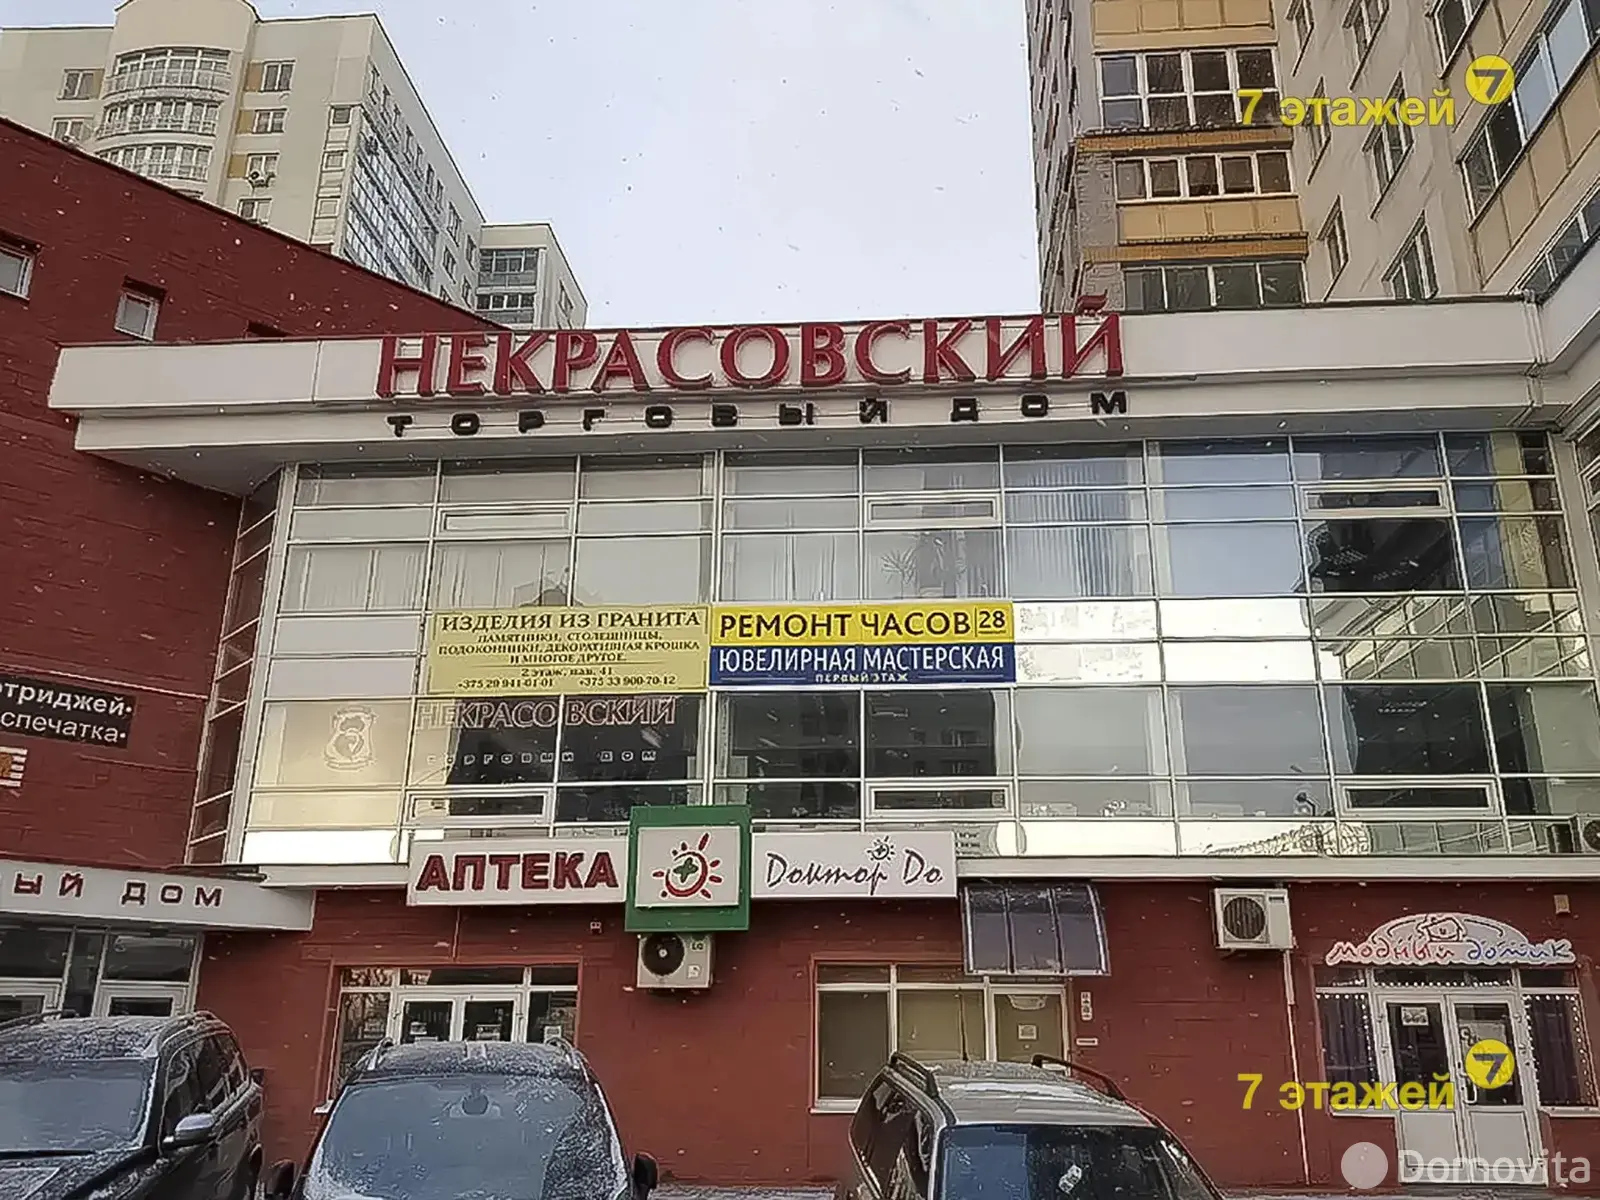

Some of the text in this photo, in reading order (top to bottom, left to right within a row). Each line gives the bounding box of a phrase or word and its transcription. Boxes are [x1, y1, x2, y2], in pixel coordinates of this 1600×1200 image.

[375, 290, 1124, 398] НЕКРАСОВСКИЙ
[386, 391, 1127, 437] ТОРГОВЫЙ ДОМ
[441, 610, 701, 633] ИЗДЕЛИЯ ИЗ ГРАНИТА
[719, 610, 1006, 638] РЕМОНТ ЧАСОВ 28
[645, 641, 700, 652] КРОШКА
[719, 646, 1004, 674] ЮВЕЛИРНАЯ МАСТЕРСКАЯ
[521, 668, 530, 677] 2
[606, 676, 622, 687] 33
[622, 675, 676, 687] 900-70-12
[415, 851, 619, 891] АПТЕКА
[766, 851, 888, 896] Доктор
[121, 882, 222, 907] ДОМ
